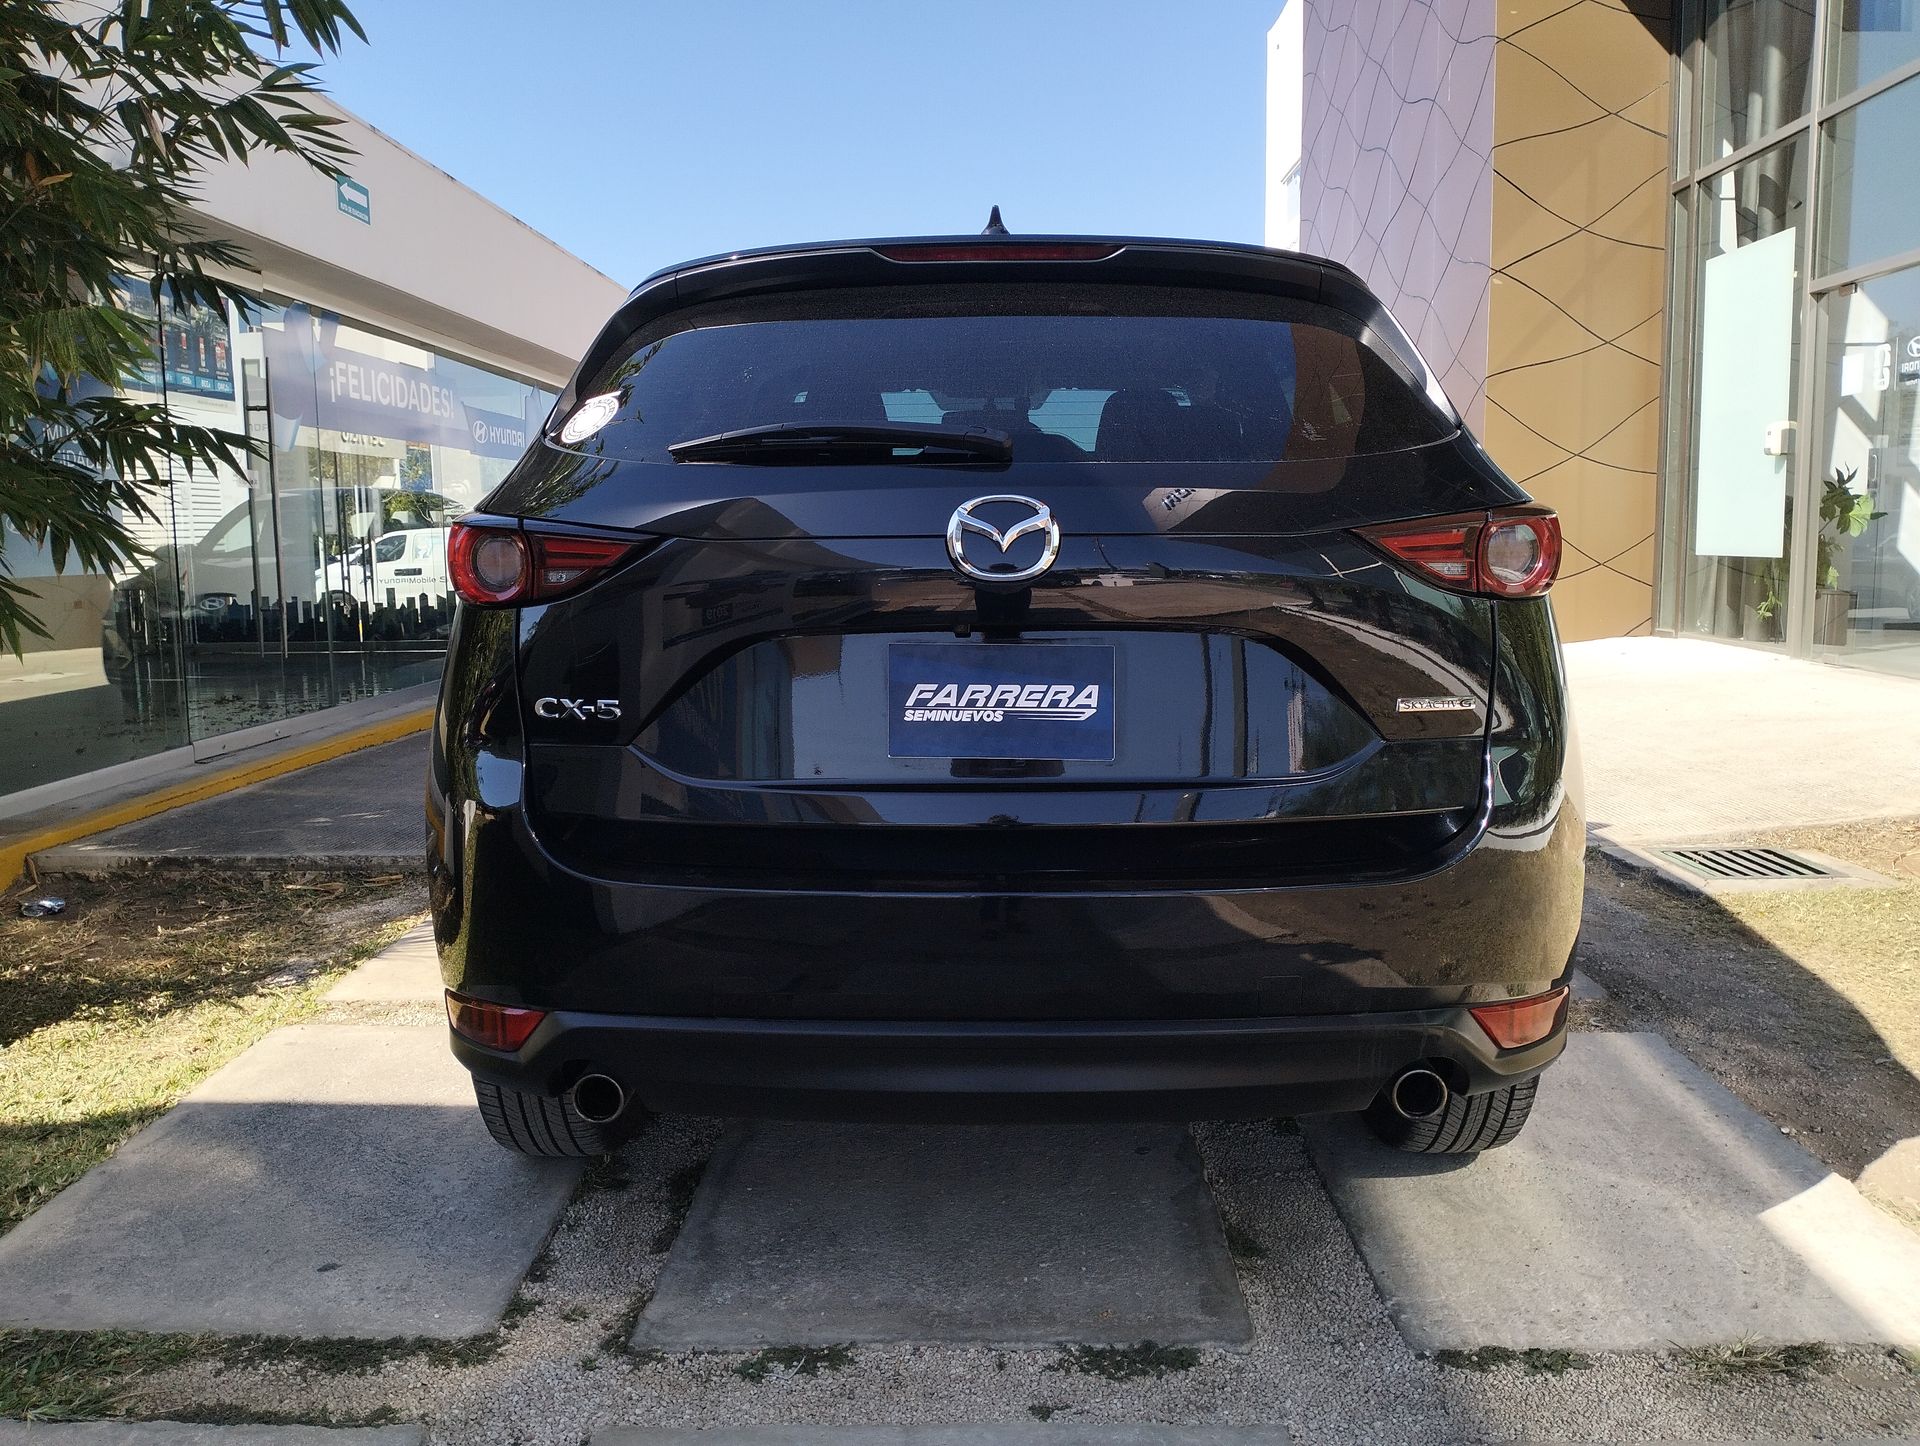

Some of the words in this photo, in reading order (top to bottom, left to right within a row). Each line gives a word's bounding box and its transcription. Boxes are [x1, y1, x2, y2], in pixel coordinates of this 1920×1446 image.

[329, 361, 455, 419] ¡FELICIDADES!
[490, 425, 525, 448] HYUNDAI
[905, 683, 1099, 708] FARRERA
[535, 697, 621, 720] CX-5
[903, 709, 1005, 722] SEMINUEVOS
